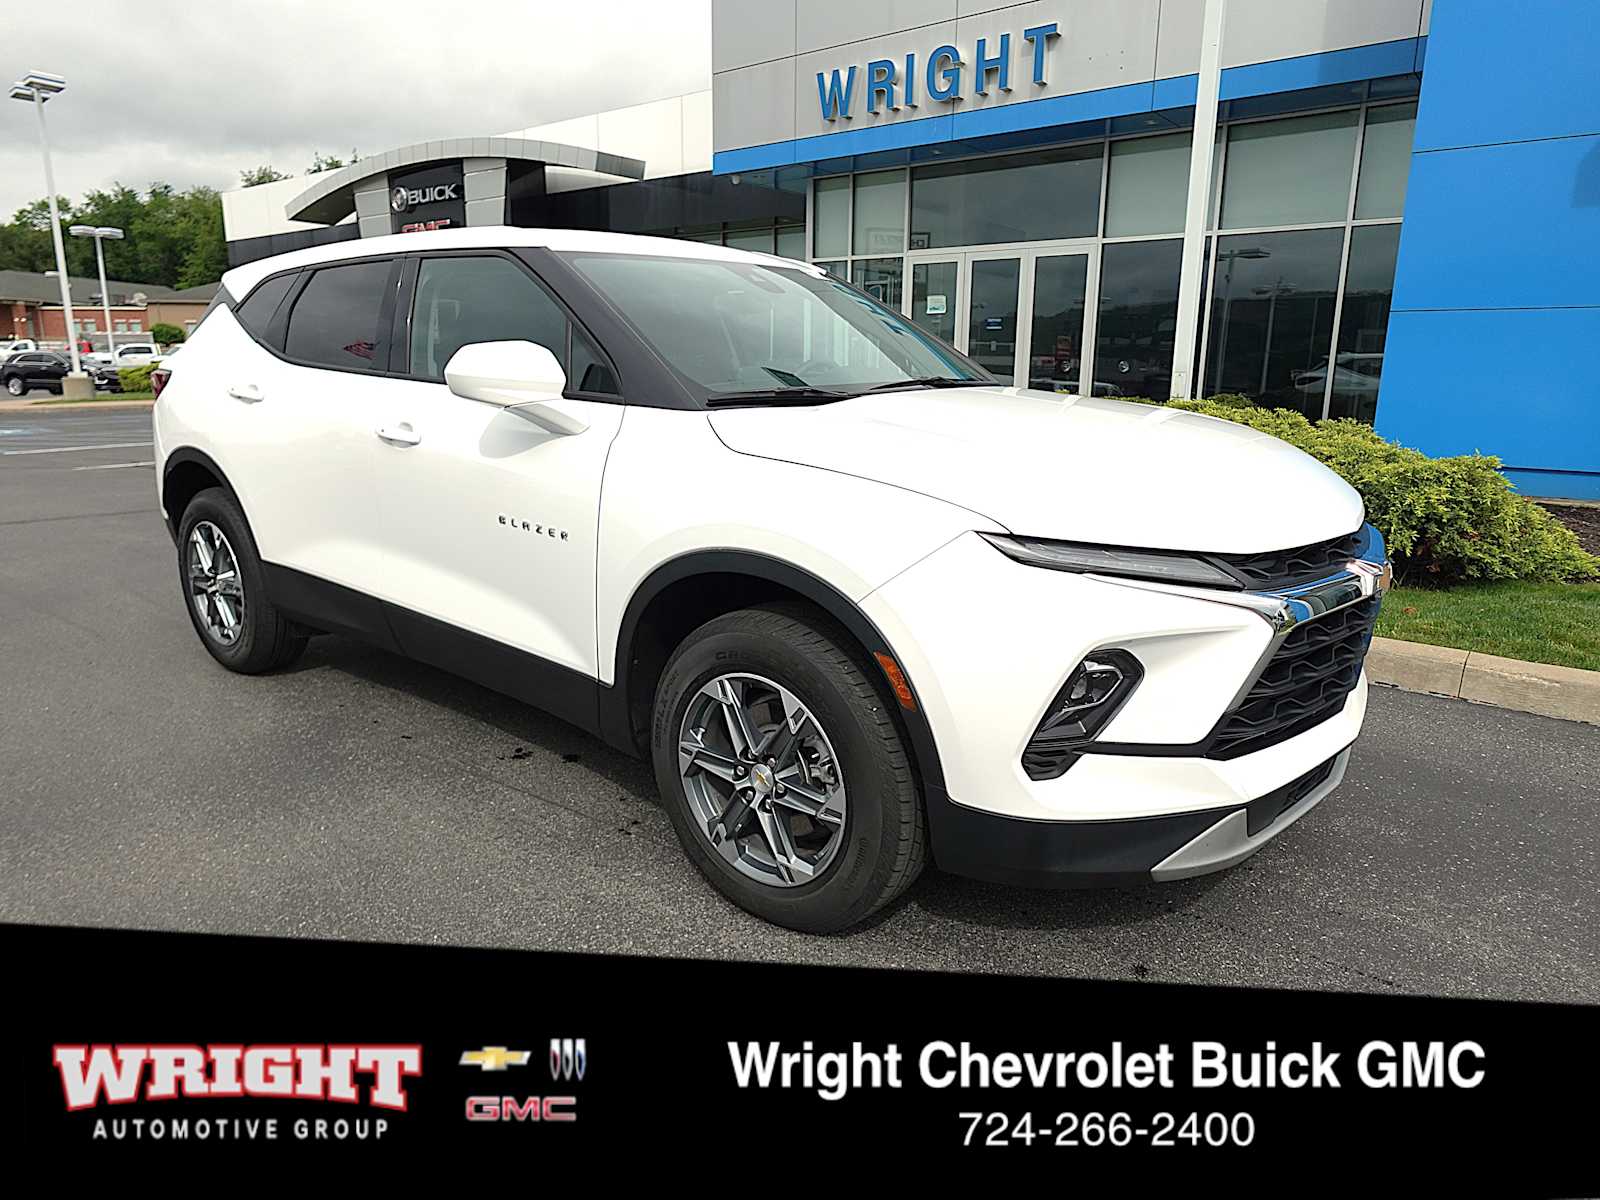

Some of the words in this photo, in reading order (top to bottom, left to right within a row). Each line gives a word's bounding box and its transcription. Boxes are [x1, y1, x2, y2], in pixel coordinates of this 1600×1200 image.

[816, 22, 1061, 121] WRIGHT
[408, 183, 458, 205] BUICK
[498, 515, 568, 542] BLAZER
